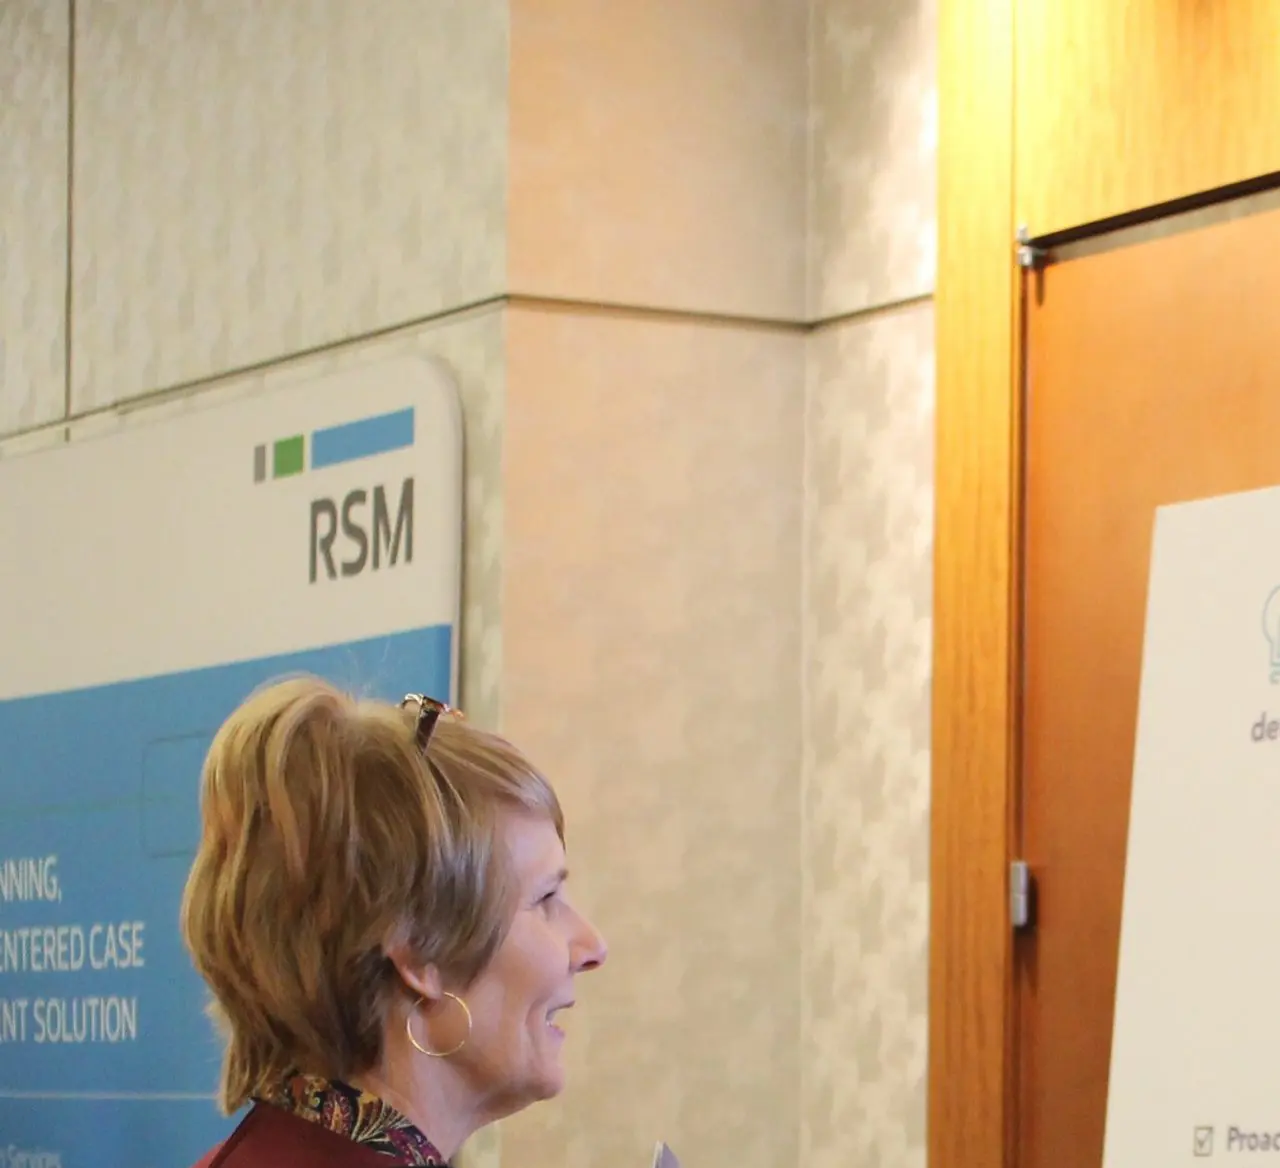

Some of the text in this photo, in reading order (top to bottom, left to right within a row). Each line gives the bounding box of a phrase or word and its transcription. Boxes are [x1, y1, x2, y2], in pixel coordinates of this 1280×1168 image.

[309, 475, 414, 584] RSM
[89, 920, 145, 970] CASE
[0, 996, 138, 1043] NT SOLUTION
